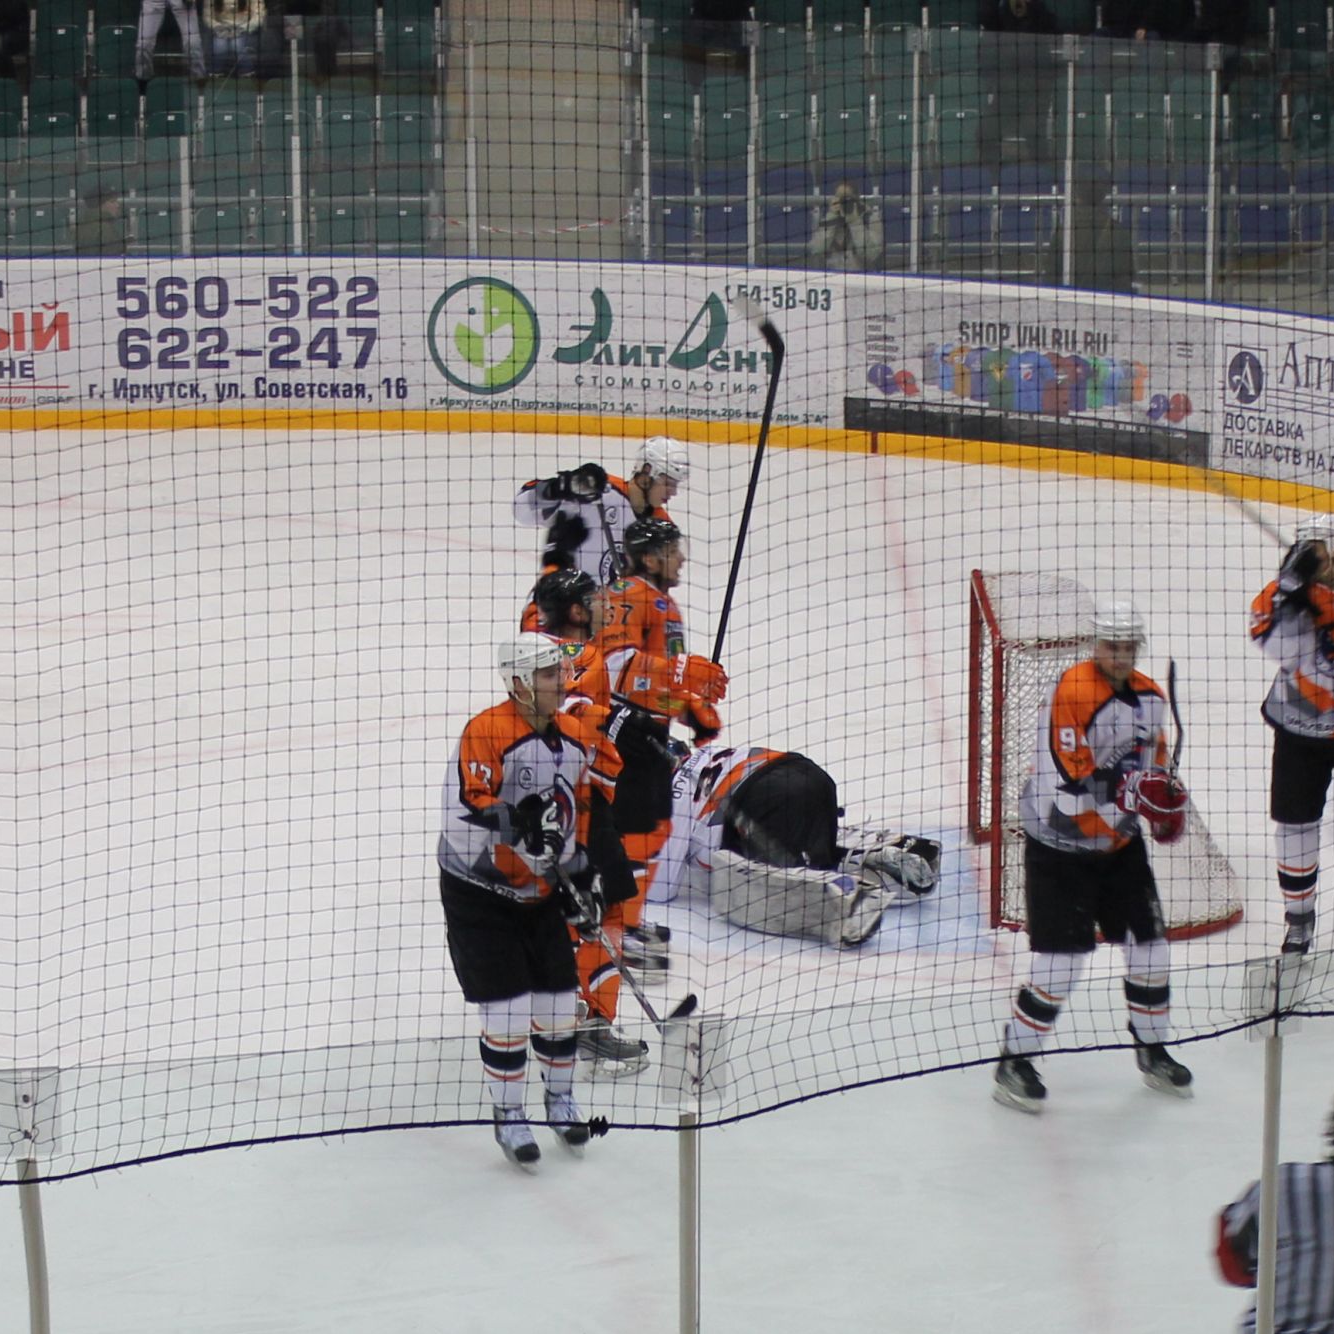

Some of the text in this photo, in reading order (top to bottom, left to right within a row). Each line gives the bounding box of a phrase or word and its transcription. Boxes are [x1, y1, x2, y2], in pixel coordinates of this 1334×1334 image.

[116, 276, 380, 319] 560-522
[117, 327, 378, 370] 622-247
[88, 377, 408, 403] г. Иркутск, ул. Советская, 16
[1223, 413, 1304, 440] ДОСТАВКА
[1223, 437, 1302, 466] ЛЕКАРСТВ
[1306, 451, 1325, 470] НА
